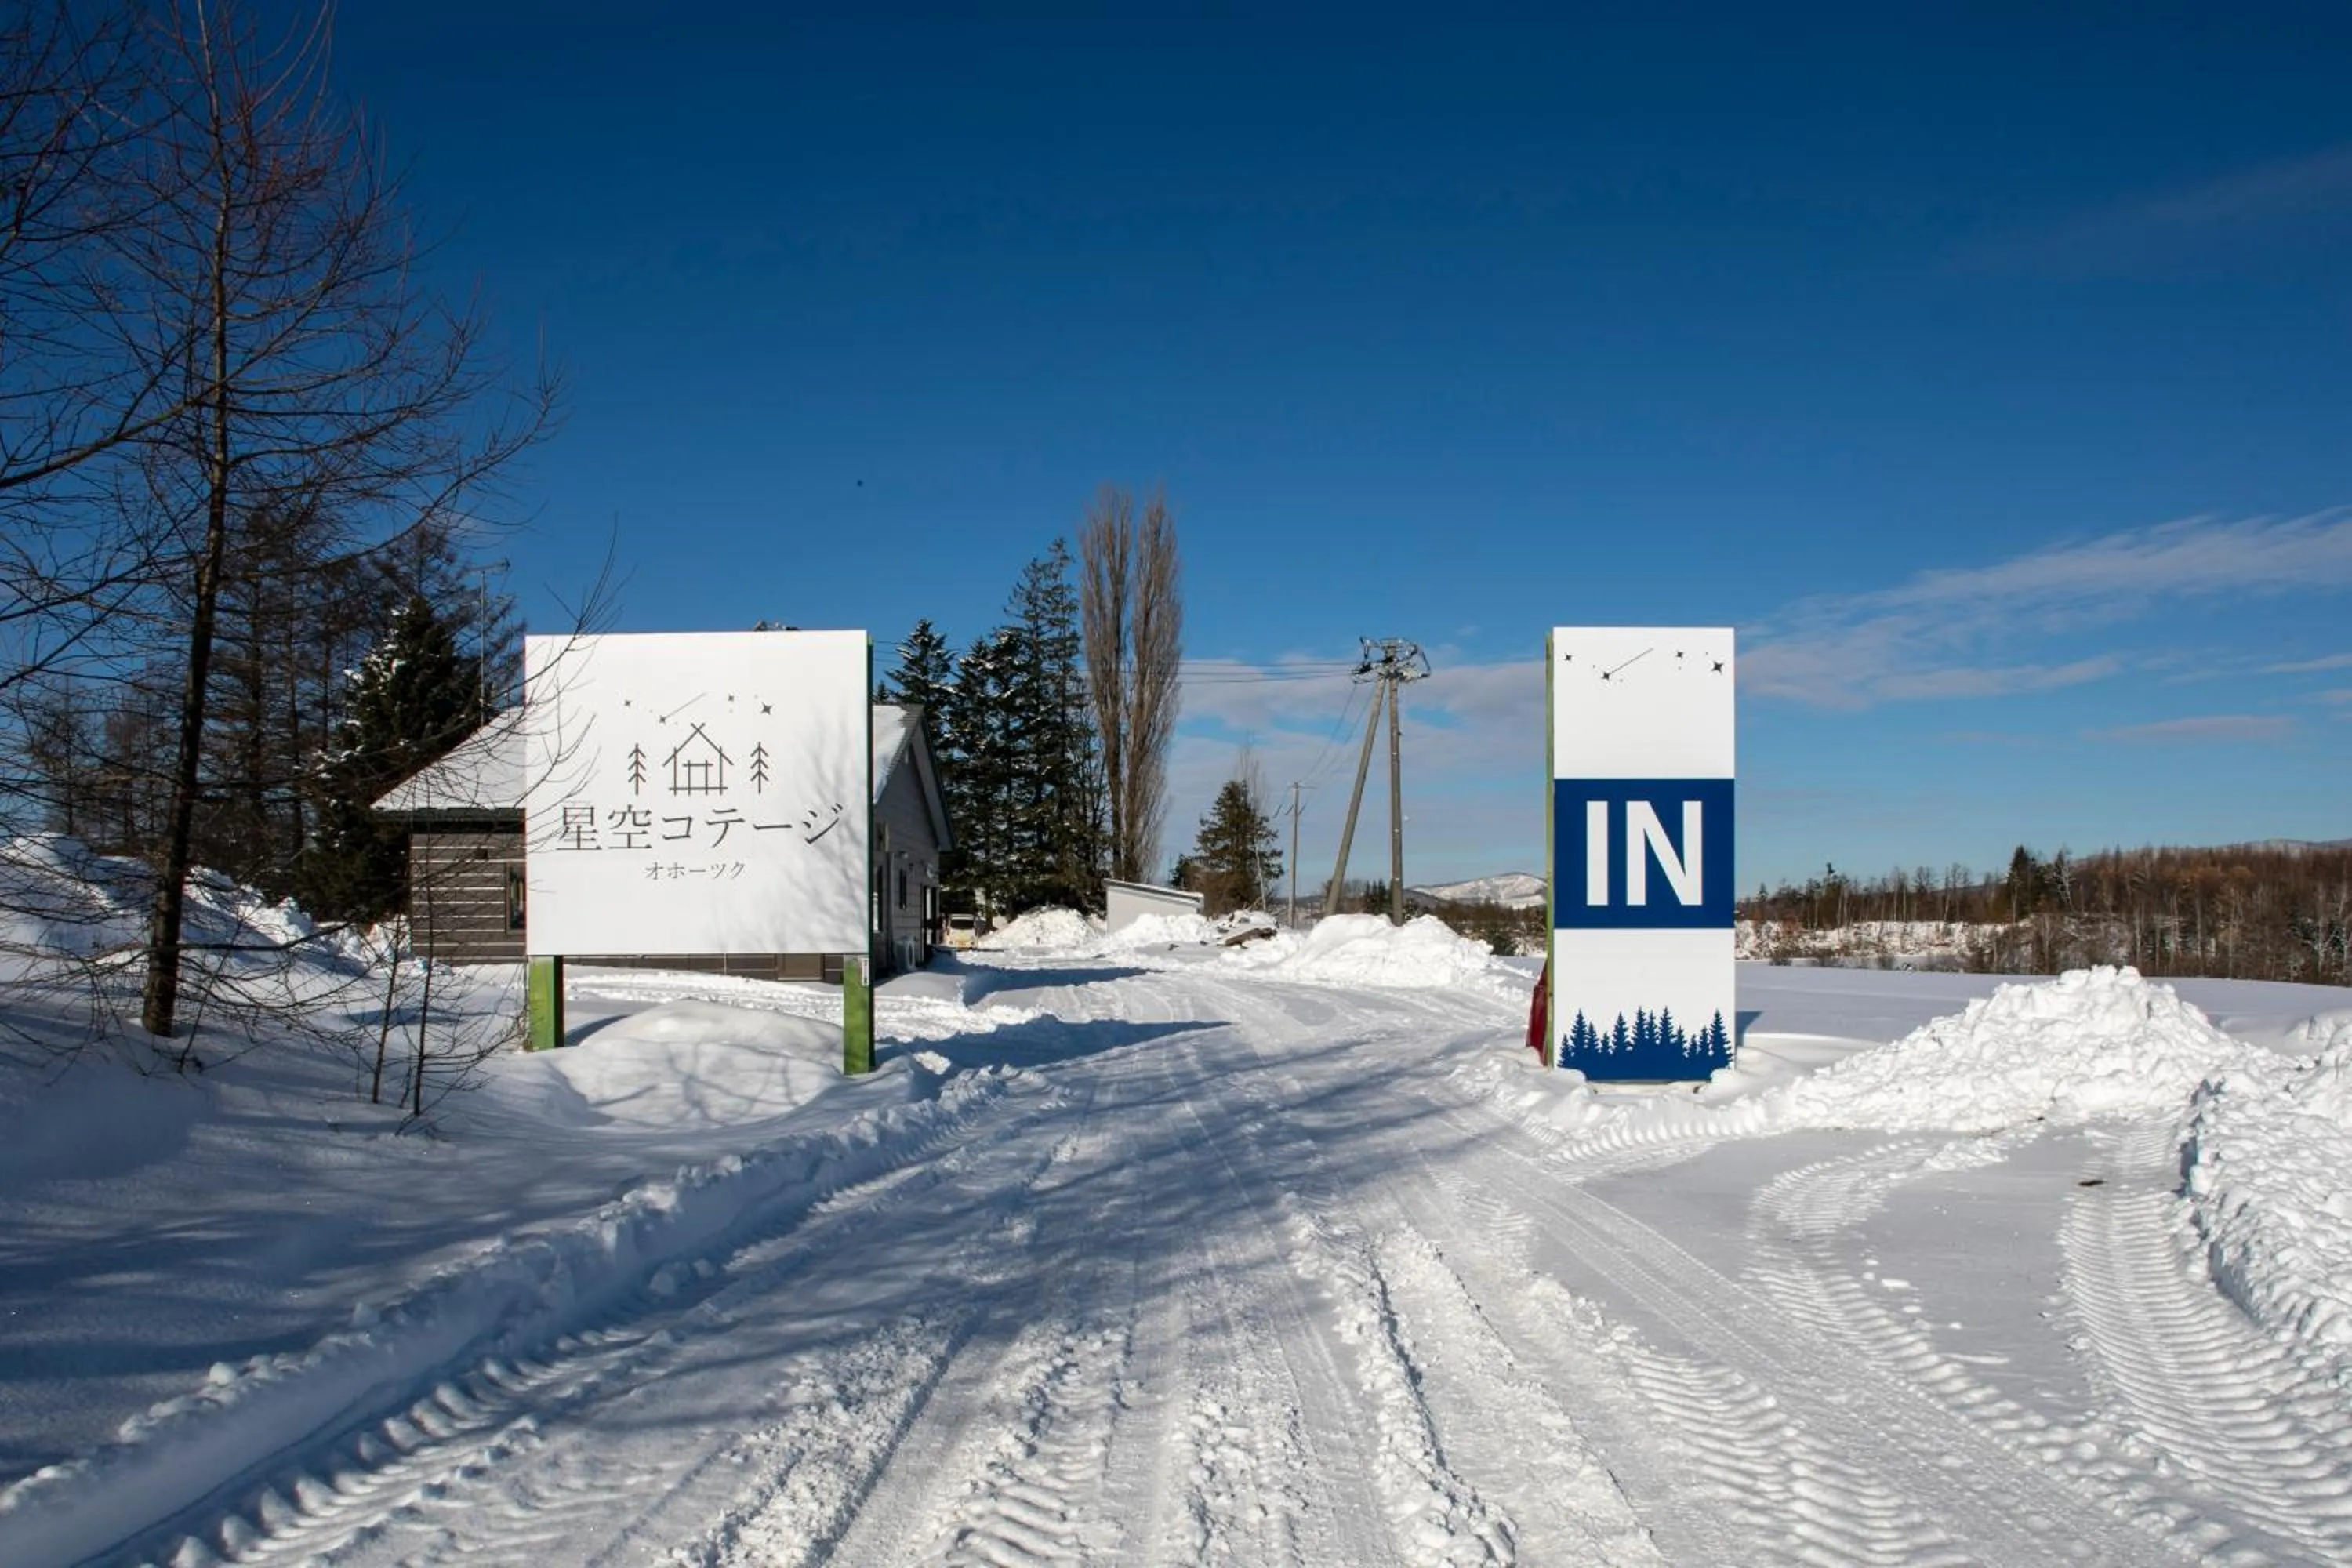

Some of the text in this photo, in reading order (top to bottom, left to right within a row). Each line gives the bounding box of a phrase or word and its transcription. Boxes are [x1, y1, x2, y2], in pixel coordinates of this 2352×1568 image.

[555, 803, 844, 851] 星空コテージ
[644, 861, 746, 880] オホーツク
[1586, 800, 1703, 906] IN
